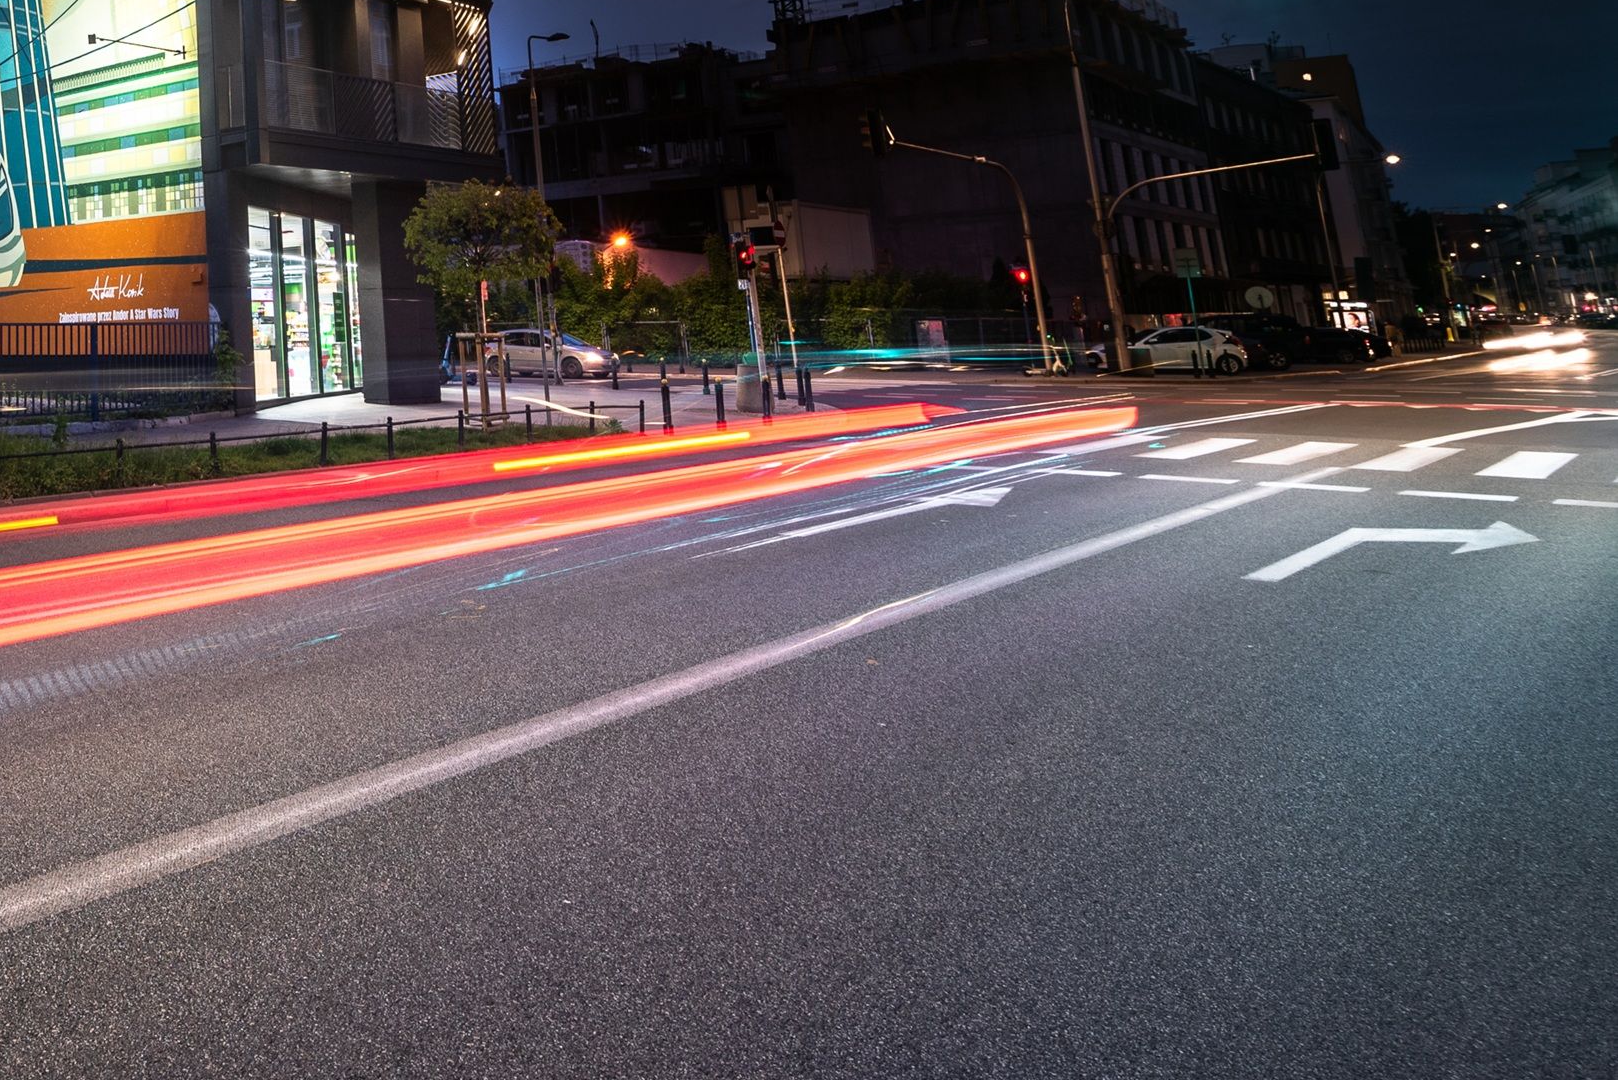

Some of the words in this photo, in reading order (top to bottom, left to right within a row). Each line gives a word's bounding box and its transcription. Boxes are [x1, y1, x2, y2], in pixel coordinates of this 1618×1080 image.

[97, 311, 112, 324] przez
[113, 309, 129, 321] Andor
[130, 308, 135, 320] A
[135, 307, 146, 320] Star
[147, 307, 162, 319] Wars
[163, 306, 179, 320] Story
